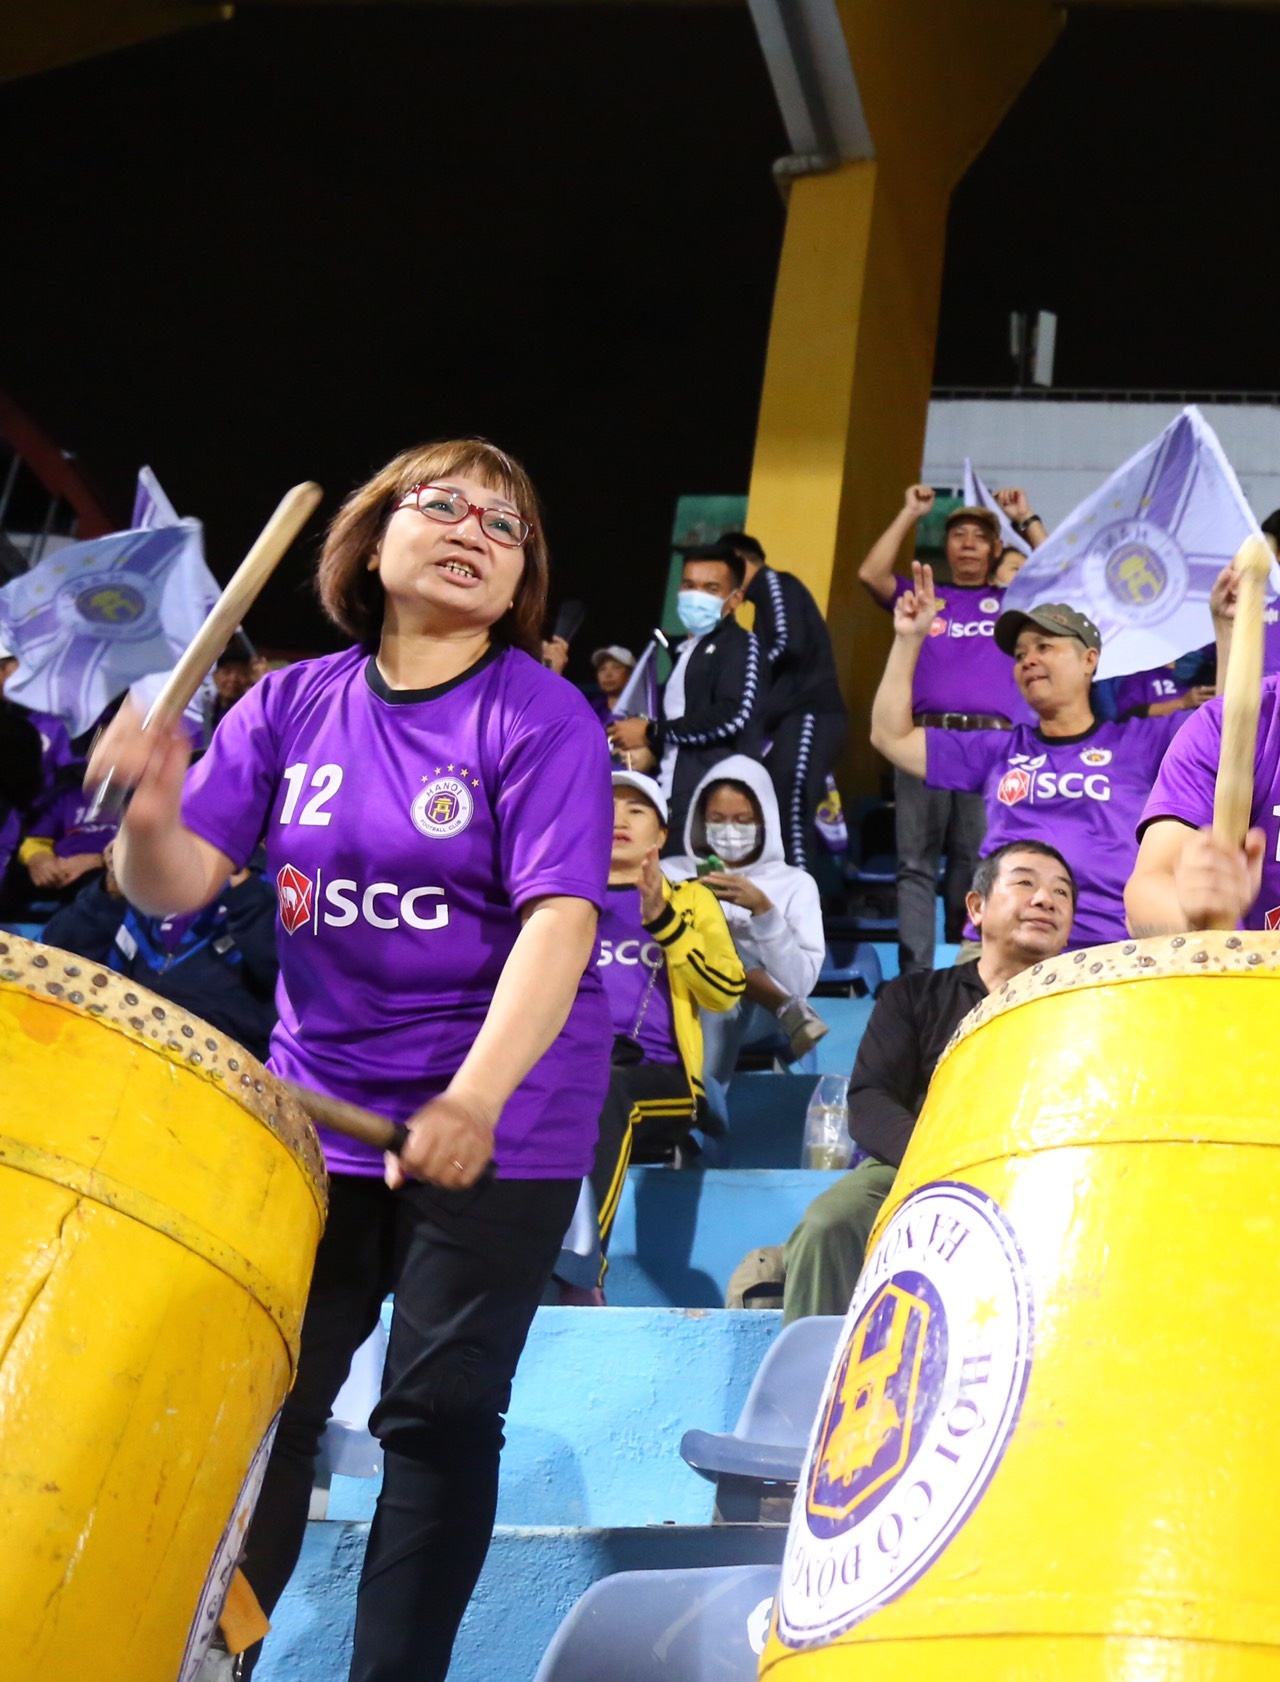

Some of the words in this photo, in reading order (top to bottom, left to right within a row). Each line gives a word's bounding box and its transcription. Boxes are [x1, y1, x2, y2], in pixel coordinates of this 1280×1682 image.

[951, 620, 995, 638] SCG
[1152, 679, 1177, 696] 12
[279, 763, 344, 826] 12
[426, 782, 463, 798] HANOI
[1036, 772, 1111, 801] SCG
[420, 819, 446, 833] FOOTBALL
[448, 820, 462, 831] CLUB
[323, 879, 449, 930] SCG
[935, 1351, 992, 1465] HỘI
